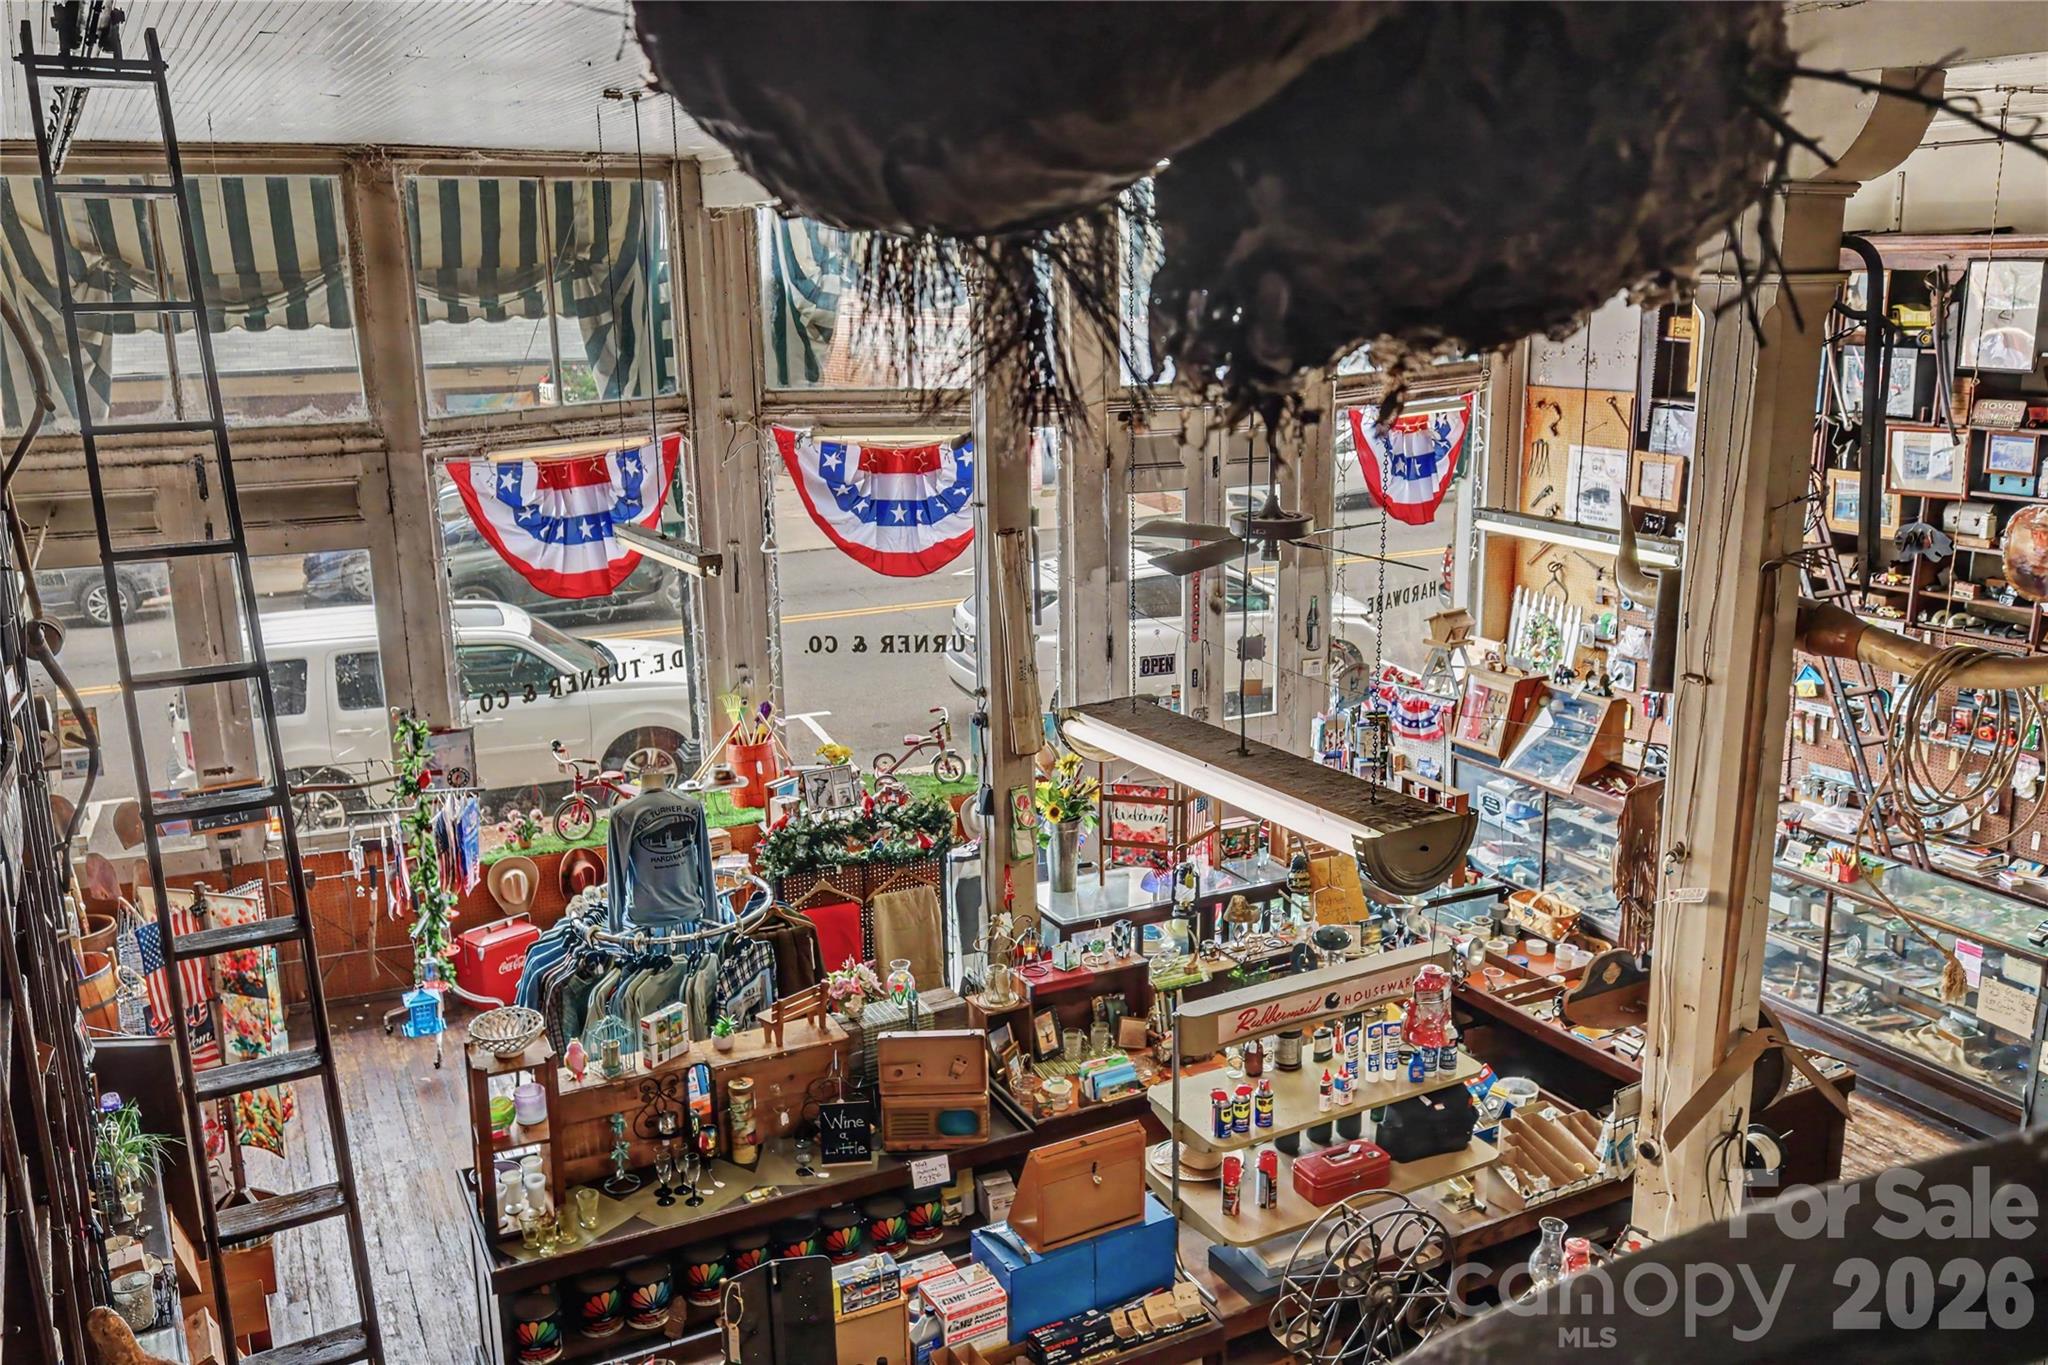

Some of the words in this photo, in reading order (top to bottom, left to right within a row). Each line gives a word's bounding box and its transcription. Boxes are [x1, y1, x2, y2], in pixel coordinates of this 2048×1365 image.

[1142, 656, 1174, 674] OPEN
[221, 811, 250, 826] Sale
[1234, 995, 1323, 1034] Rubbermaid
[1343, 972, 1416, 1005] HOUSEWAR
[822, 1108, 866, 1130] Wine
